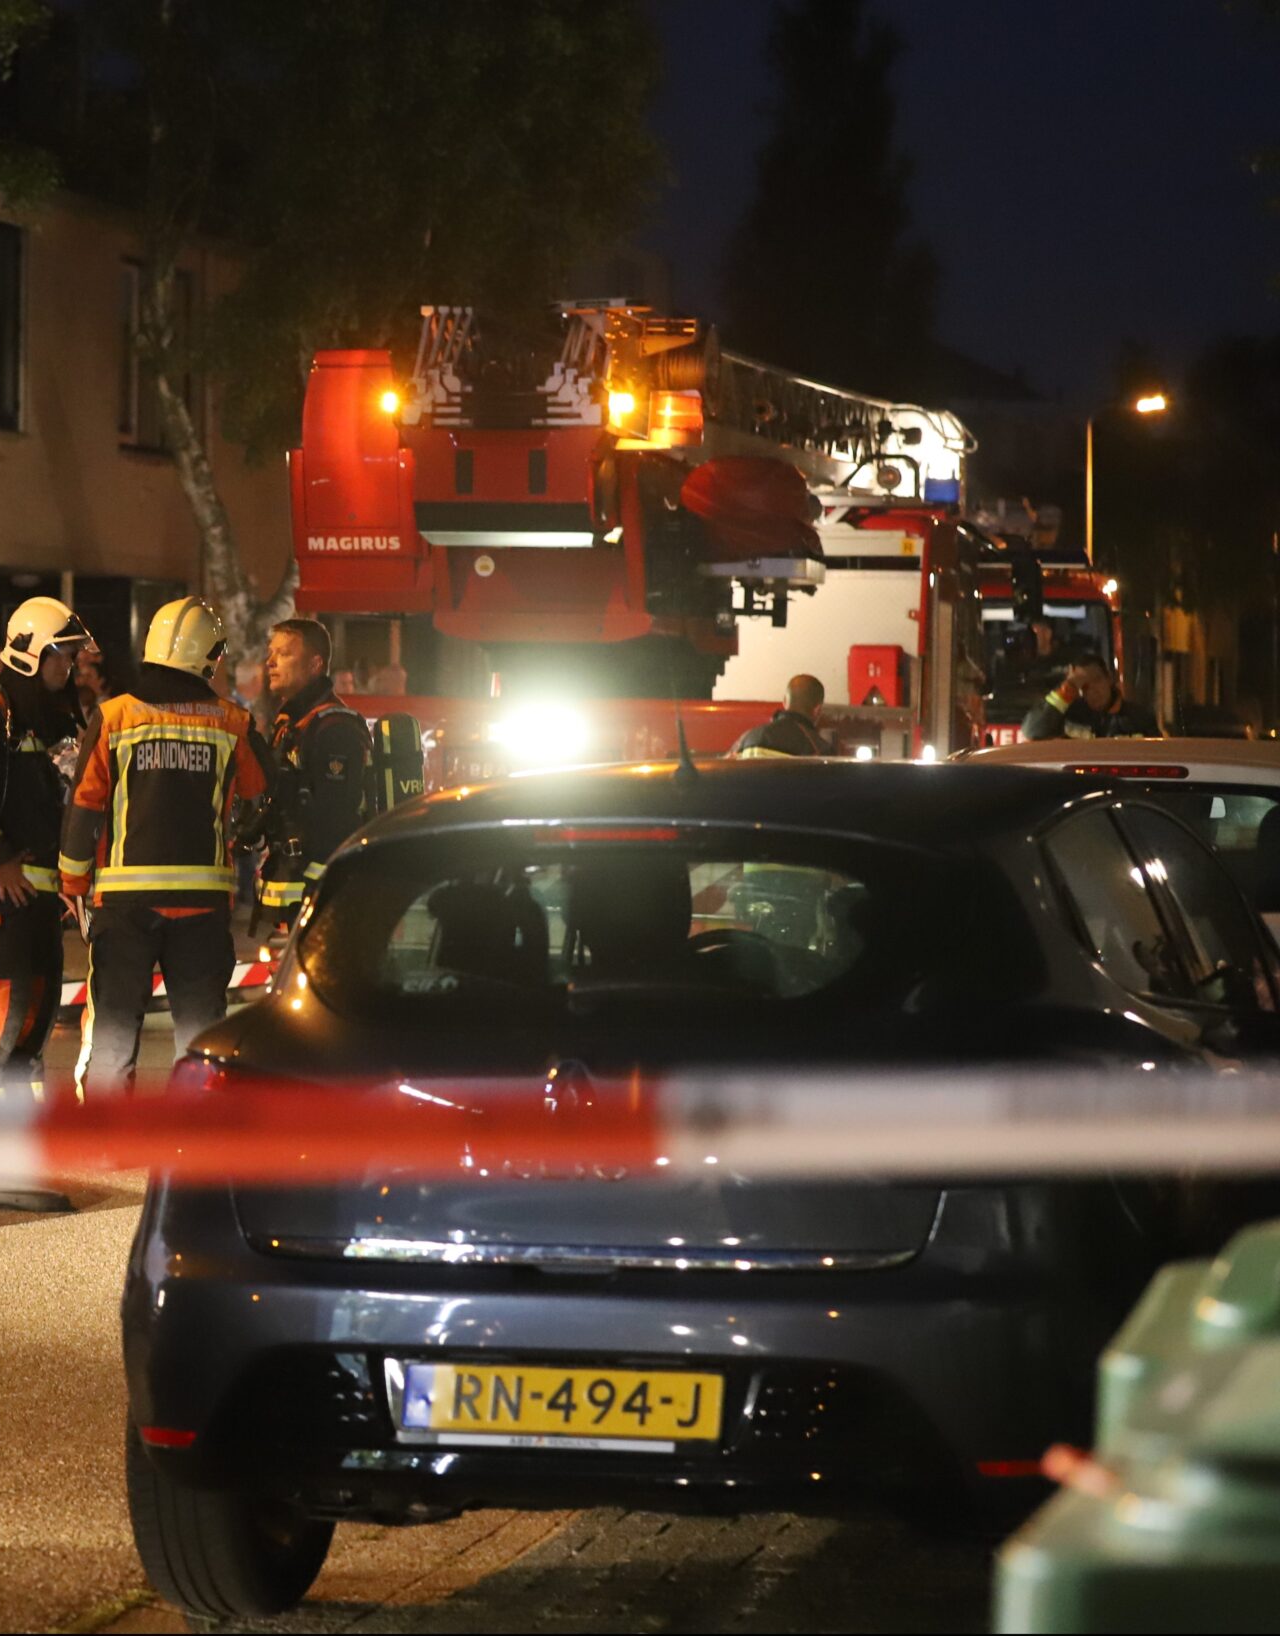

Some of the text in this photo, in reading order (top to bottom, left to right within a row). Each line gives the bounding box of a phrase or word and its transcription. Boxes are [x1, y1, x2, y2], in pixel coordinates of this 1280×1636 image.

[307, 536, 401, 551] MAGIRUS
[173, 702, 194, 715] VAN
[136, 741, 211, 772] BRANDWEER
[450, 1373, 702, 1429] RN-494-J
